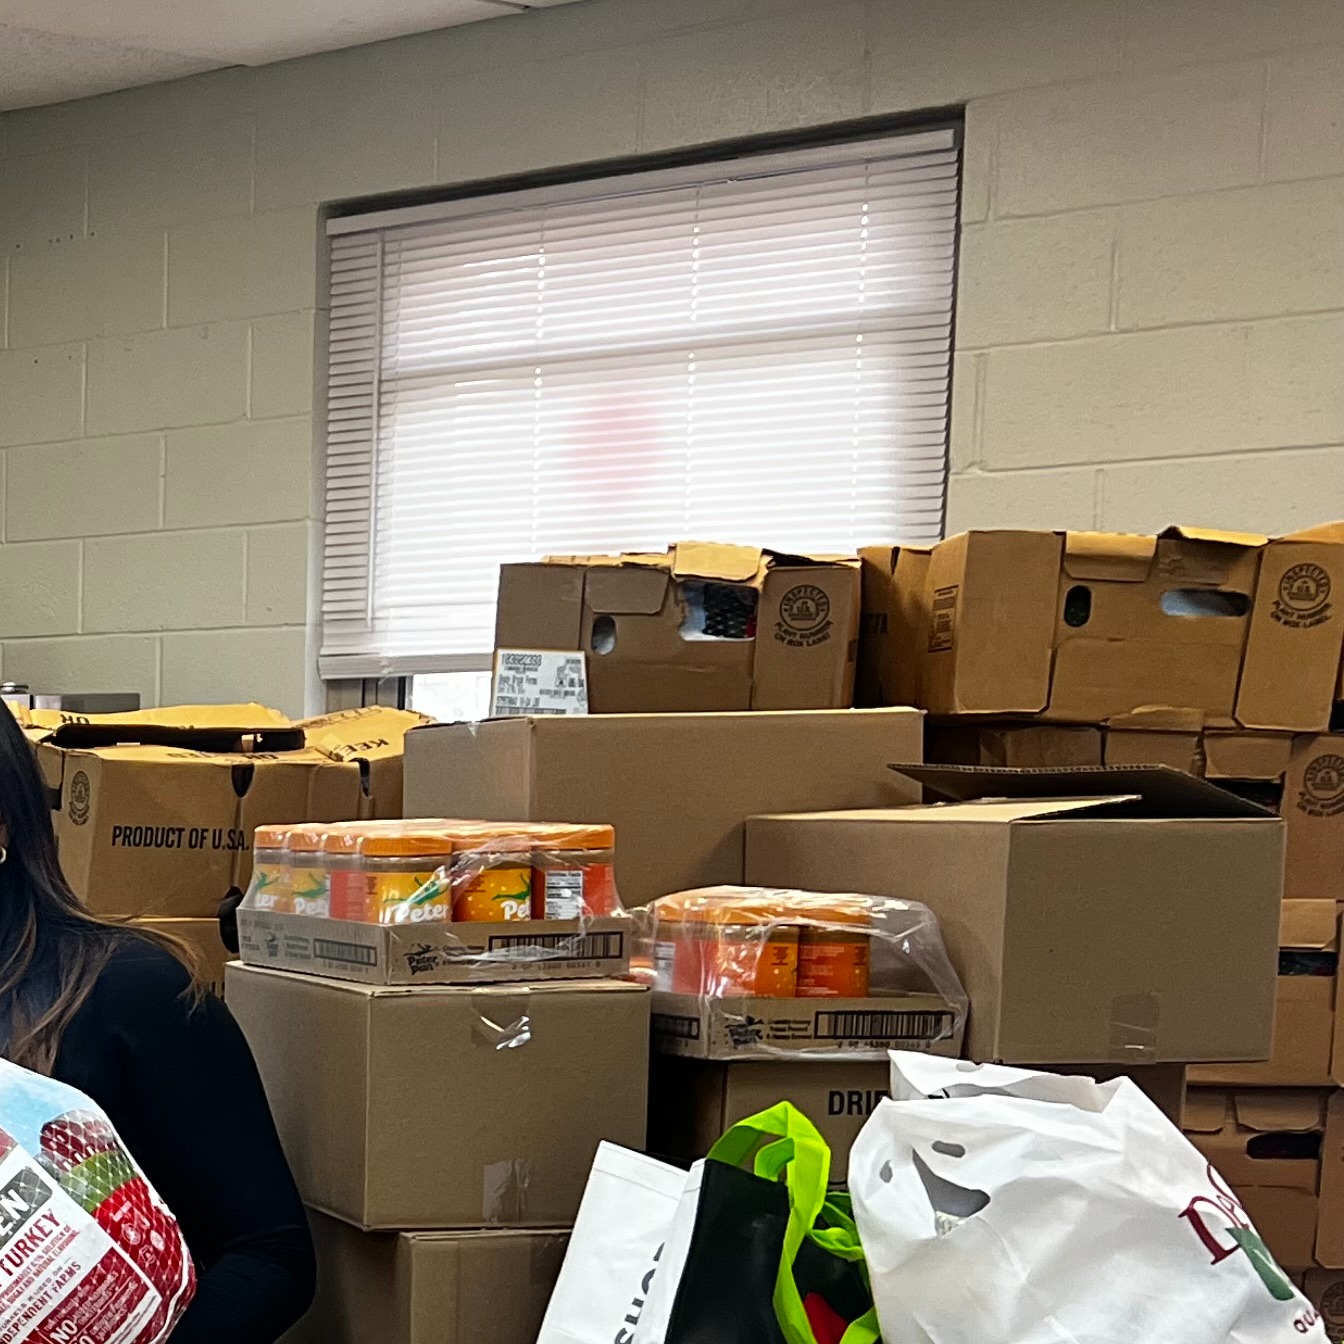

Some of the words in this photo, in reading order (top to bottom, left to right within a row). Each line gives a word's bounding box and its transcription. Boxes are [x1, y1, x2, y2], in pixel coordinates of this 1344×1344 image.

[112, 825, 186, 848] PRODUCT
[188, 827, 210, 850] OF
[49, 1260, 82, 1294] FARMS
